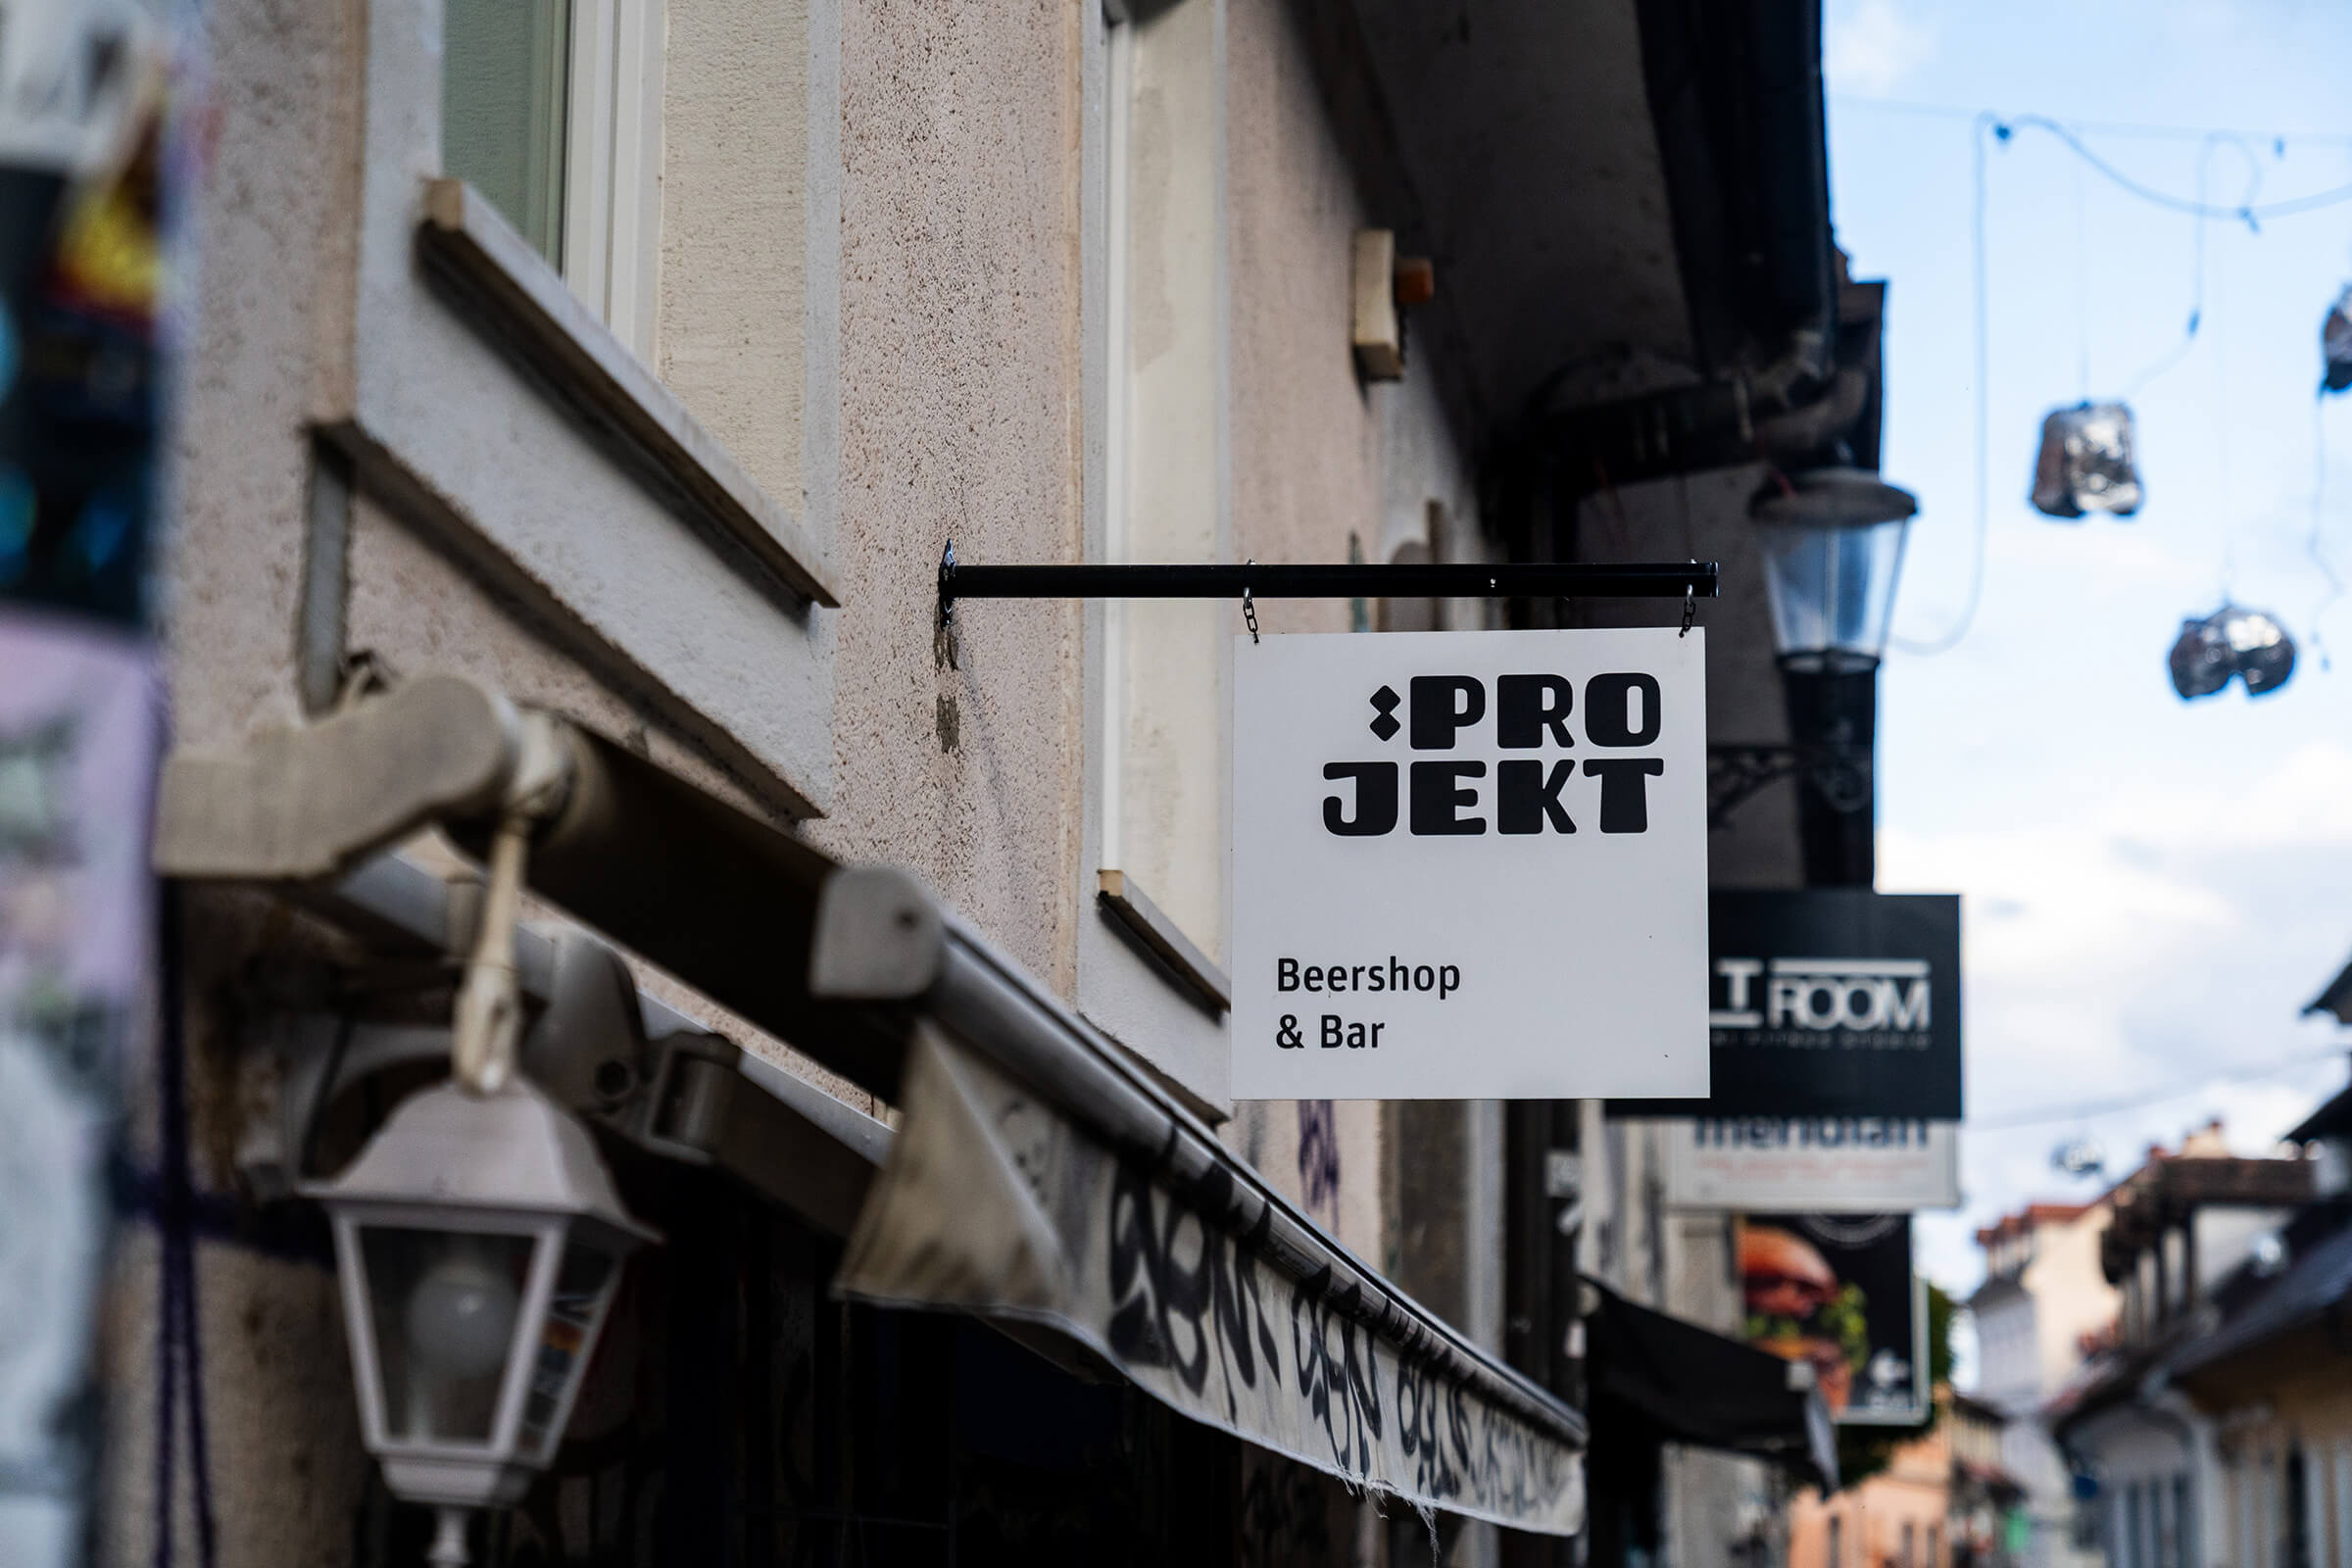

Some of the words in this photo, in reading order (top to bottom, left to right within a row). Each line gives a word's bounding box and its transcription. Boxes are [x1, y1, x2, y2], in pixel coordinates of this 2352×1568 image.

[1323, 759, 1663, 836] JEKT
[1278, 956, 1459, 1000] Beershop
[1768, 976, 1932, 1031] ROOM
[1276, 1014, 1304, 1049] &
[1321, 1015, 1385, 1049] Bar
